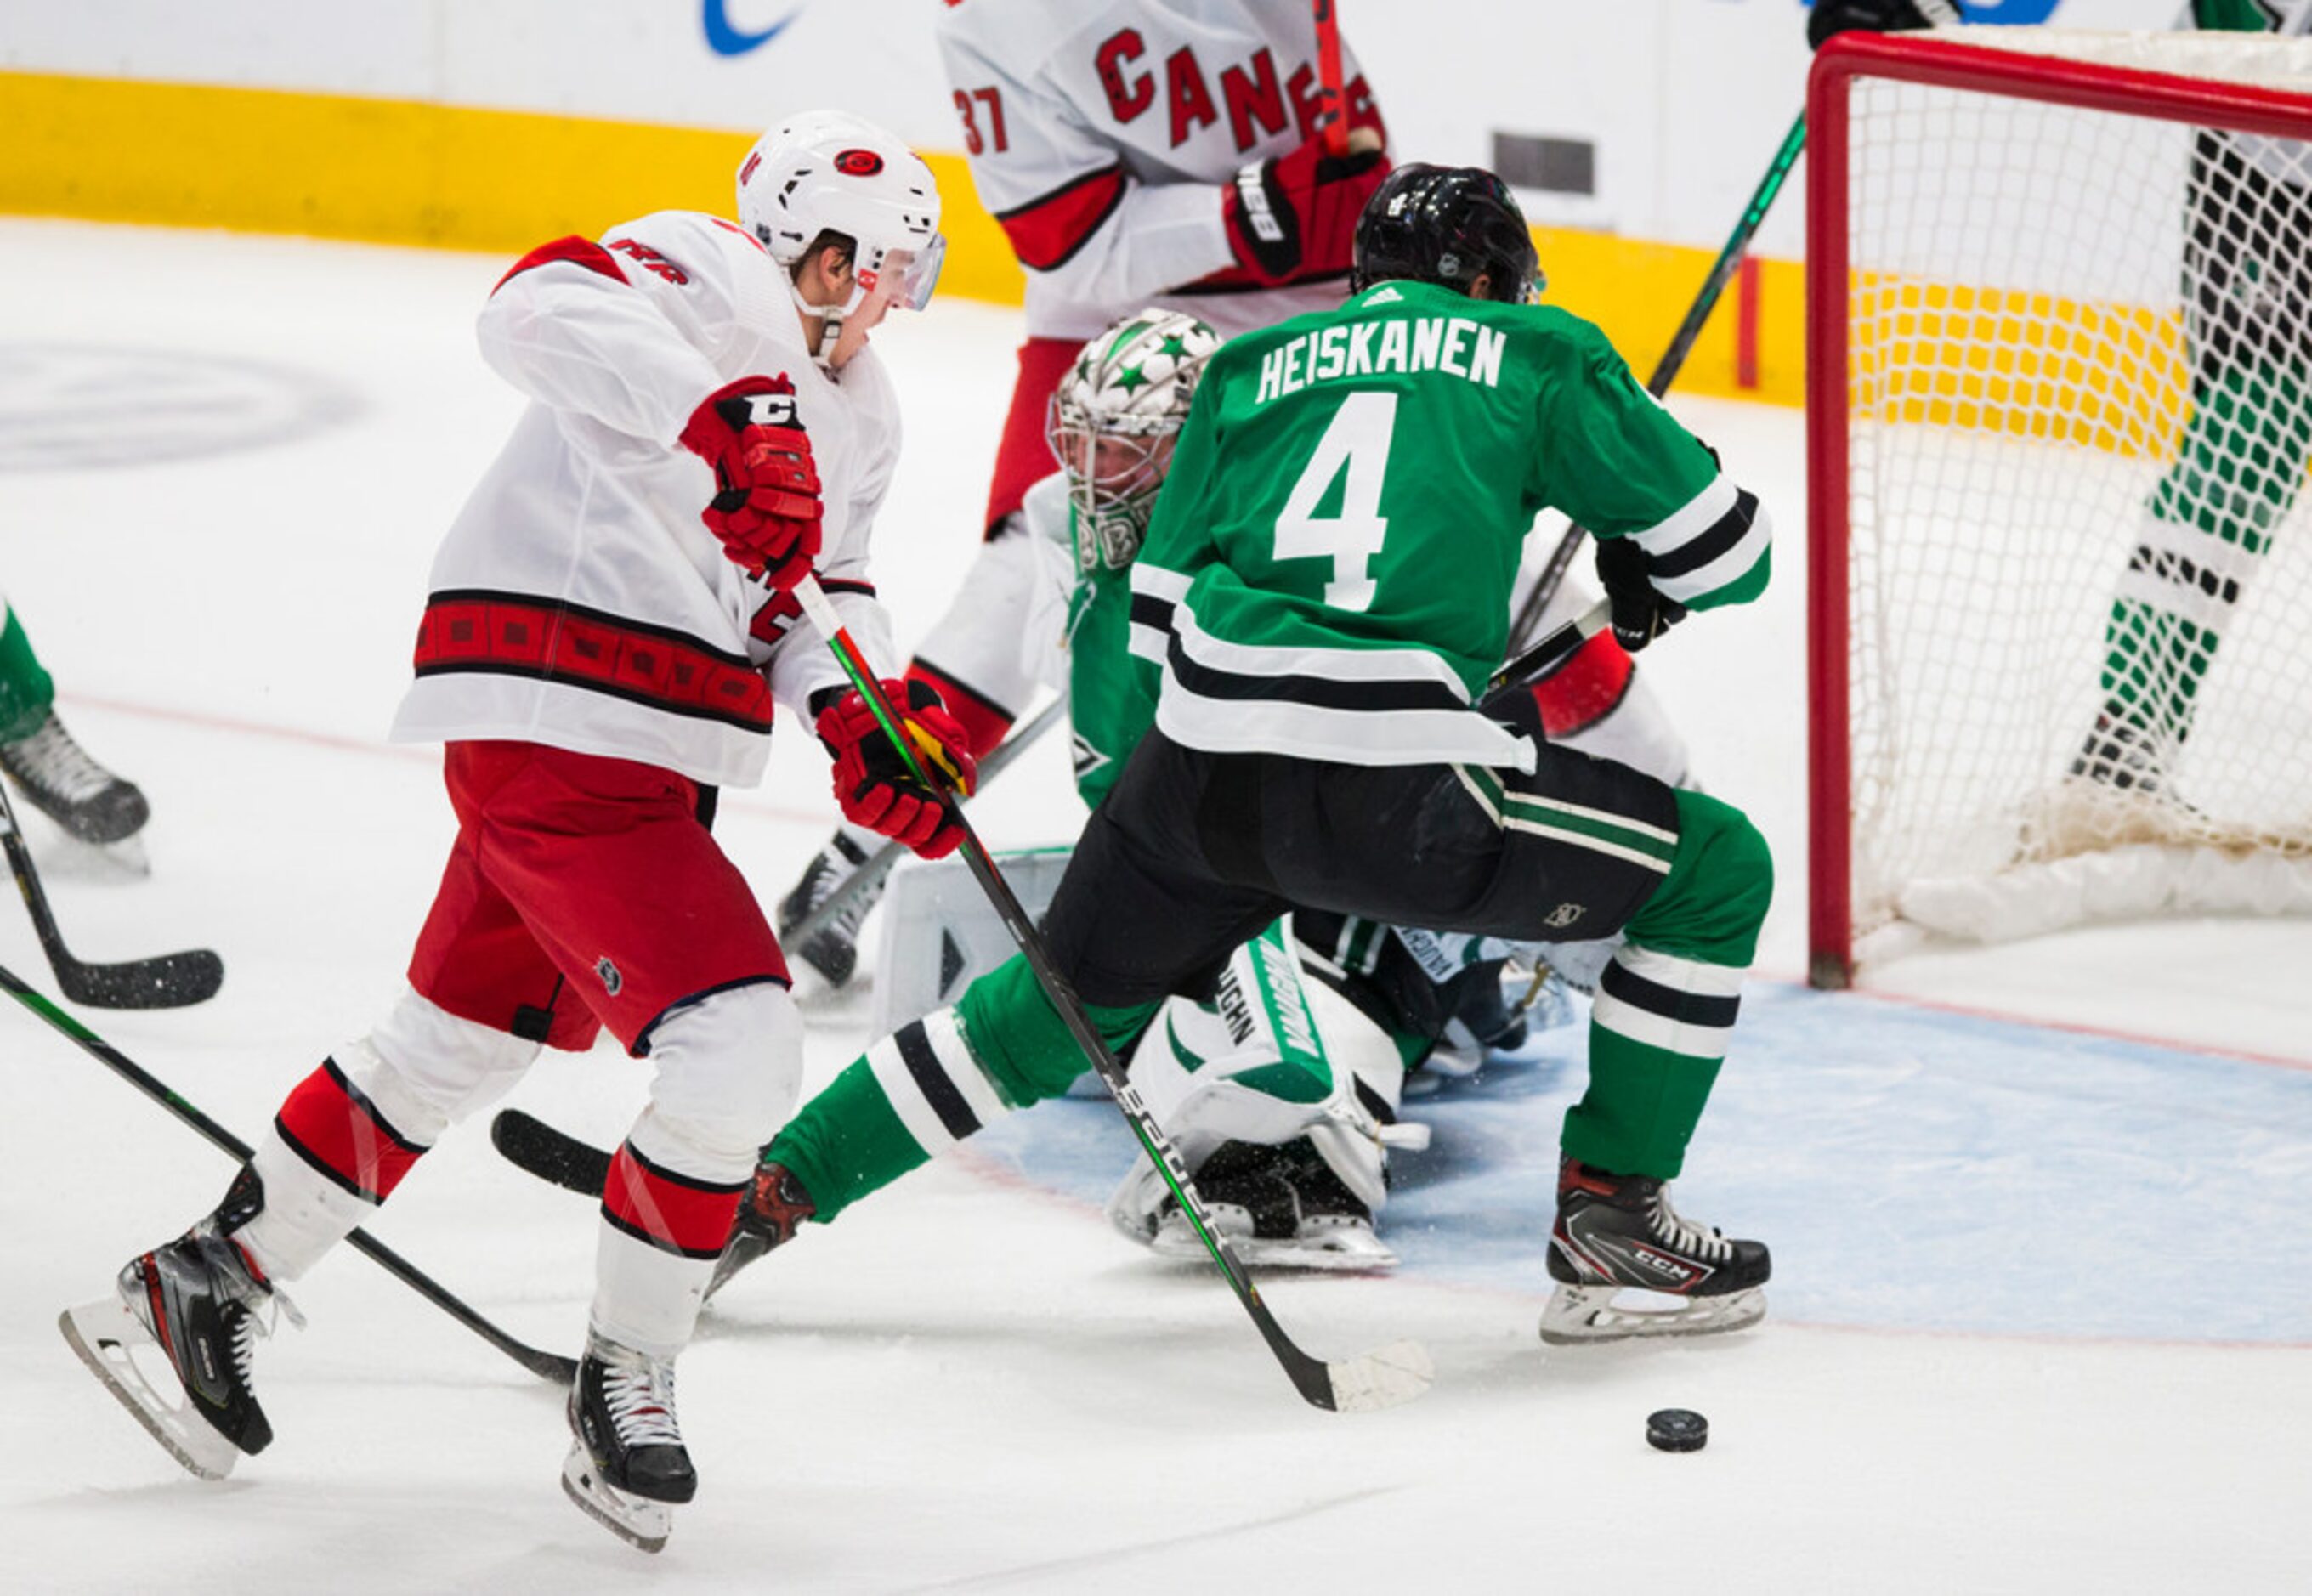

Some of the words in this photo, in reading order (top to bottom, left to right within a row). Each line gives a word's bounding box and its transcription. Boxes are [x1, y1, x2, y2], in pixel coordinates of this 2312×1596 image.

[953, 86, 1008, 156] 37
[1255, 318, 1506, 404] HEISKANEN
[1272, 392, 1398, 613] 4
[1635, 1251, 1692, 1279] CCM
